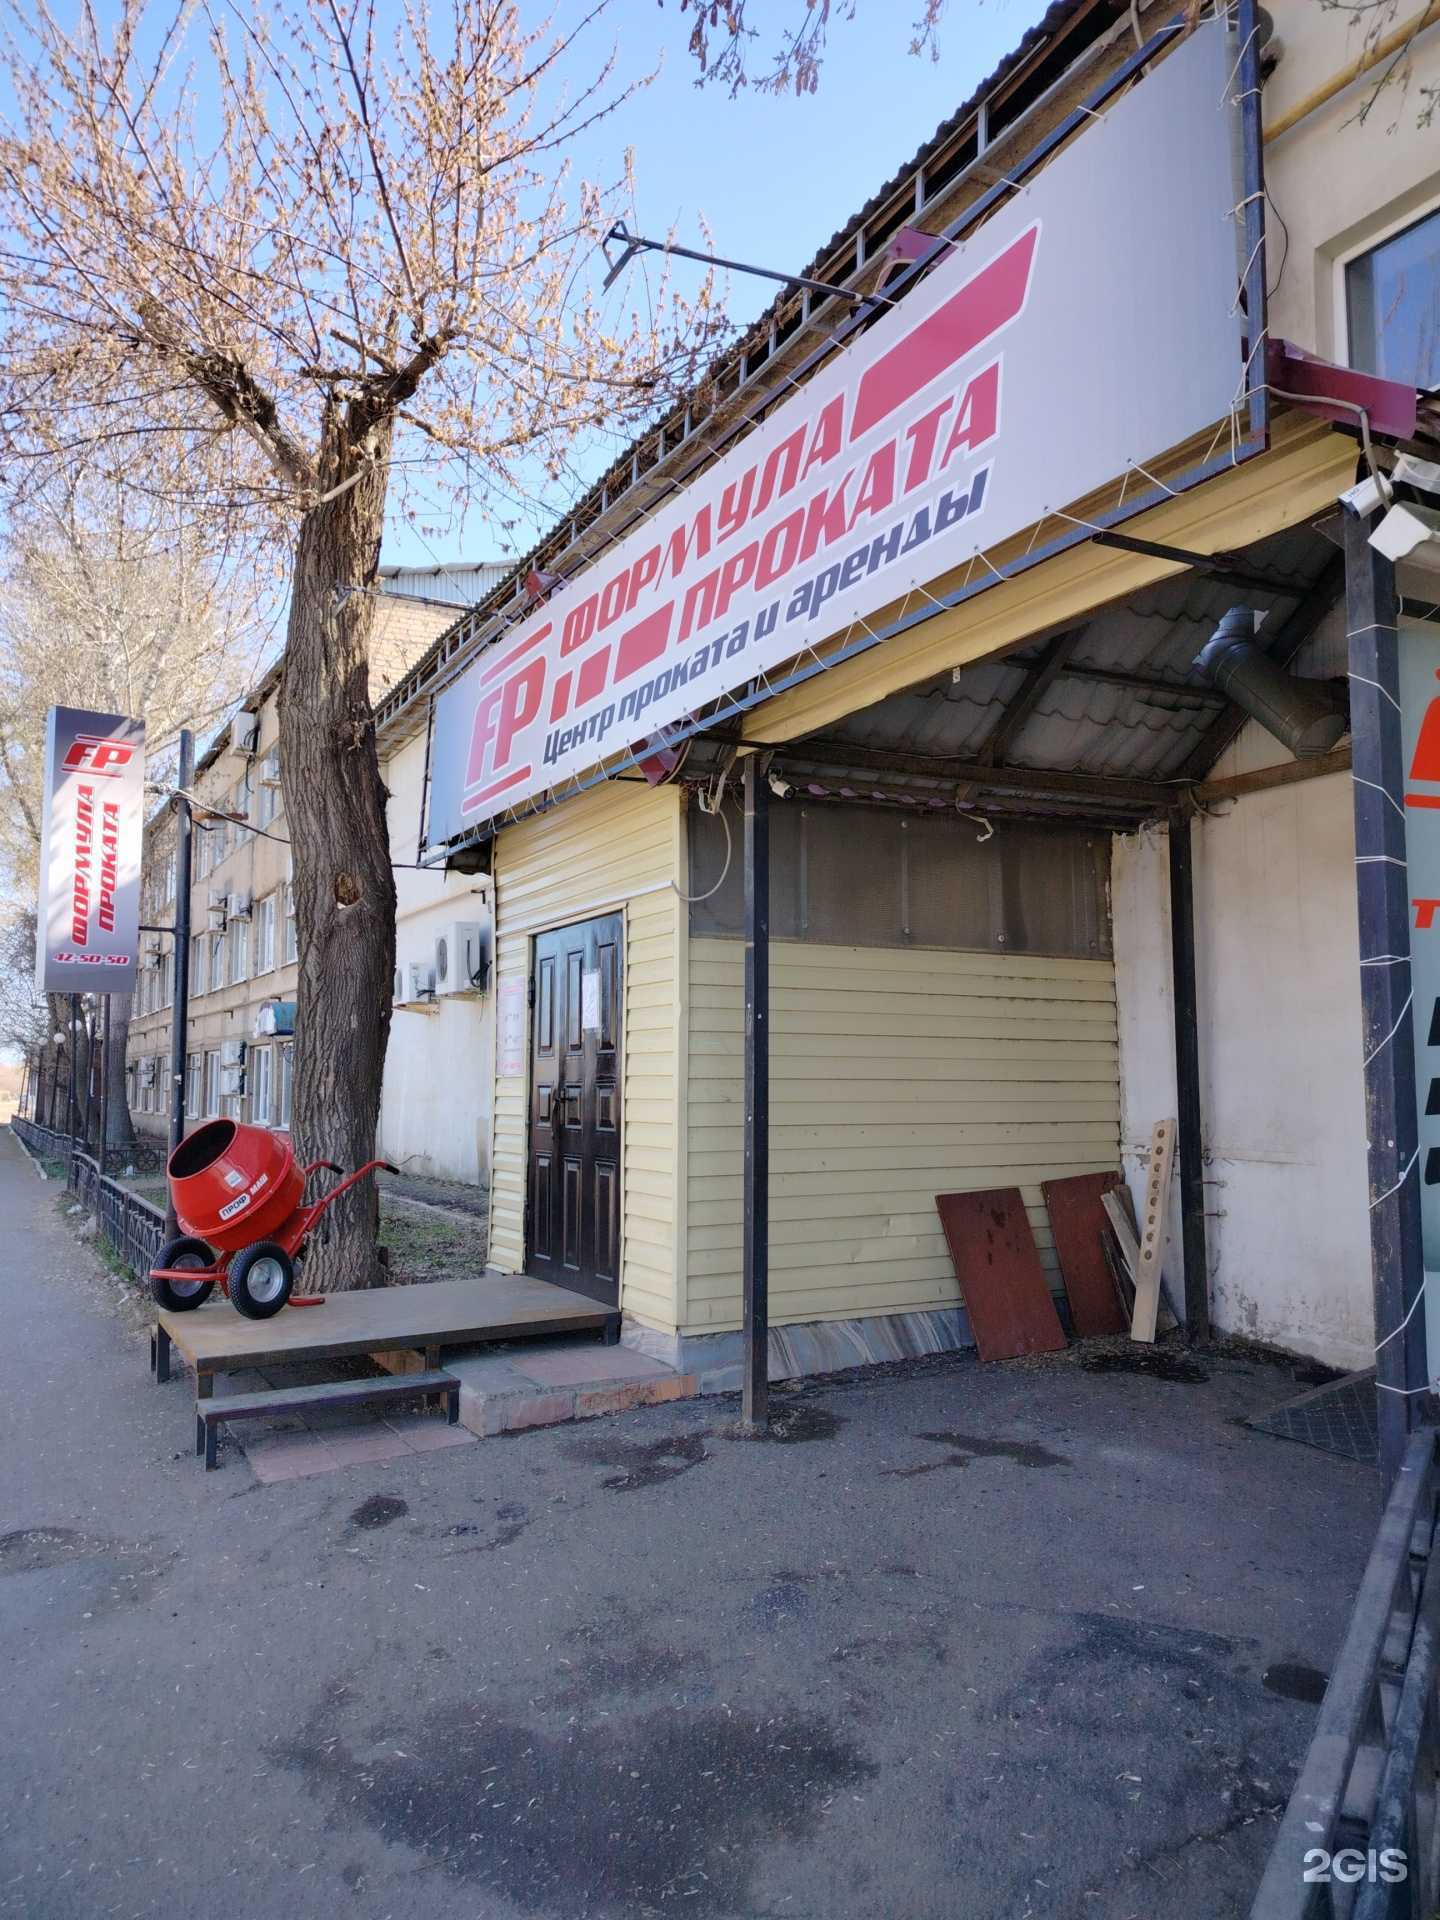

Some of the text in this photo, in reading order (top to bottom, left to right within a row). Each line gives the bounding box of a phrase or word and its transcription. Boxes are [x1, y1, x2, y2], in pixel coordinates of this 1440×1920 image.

[542, 466, 990, 766] Центр проката и аренды
[559, 391, 846, 658] ФОРМУЛА
[676, 360, 1000, 645] ПРОКАТА
[71, 783, 95, 947] ФОРМУЛА
[99, 801, 120, 933] ПРОКАТА
